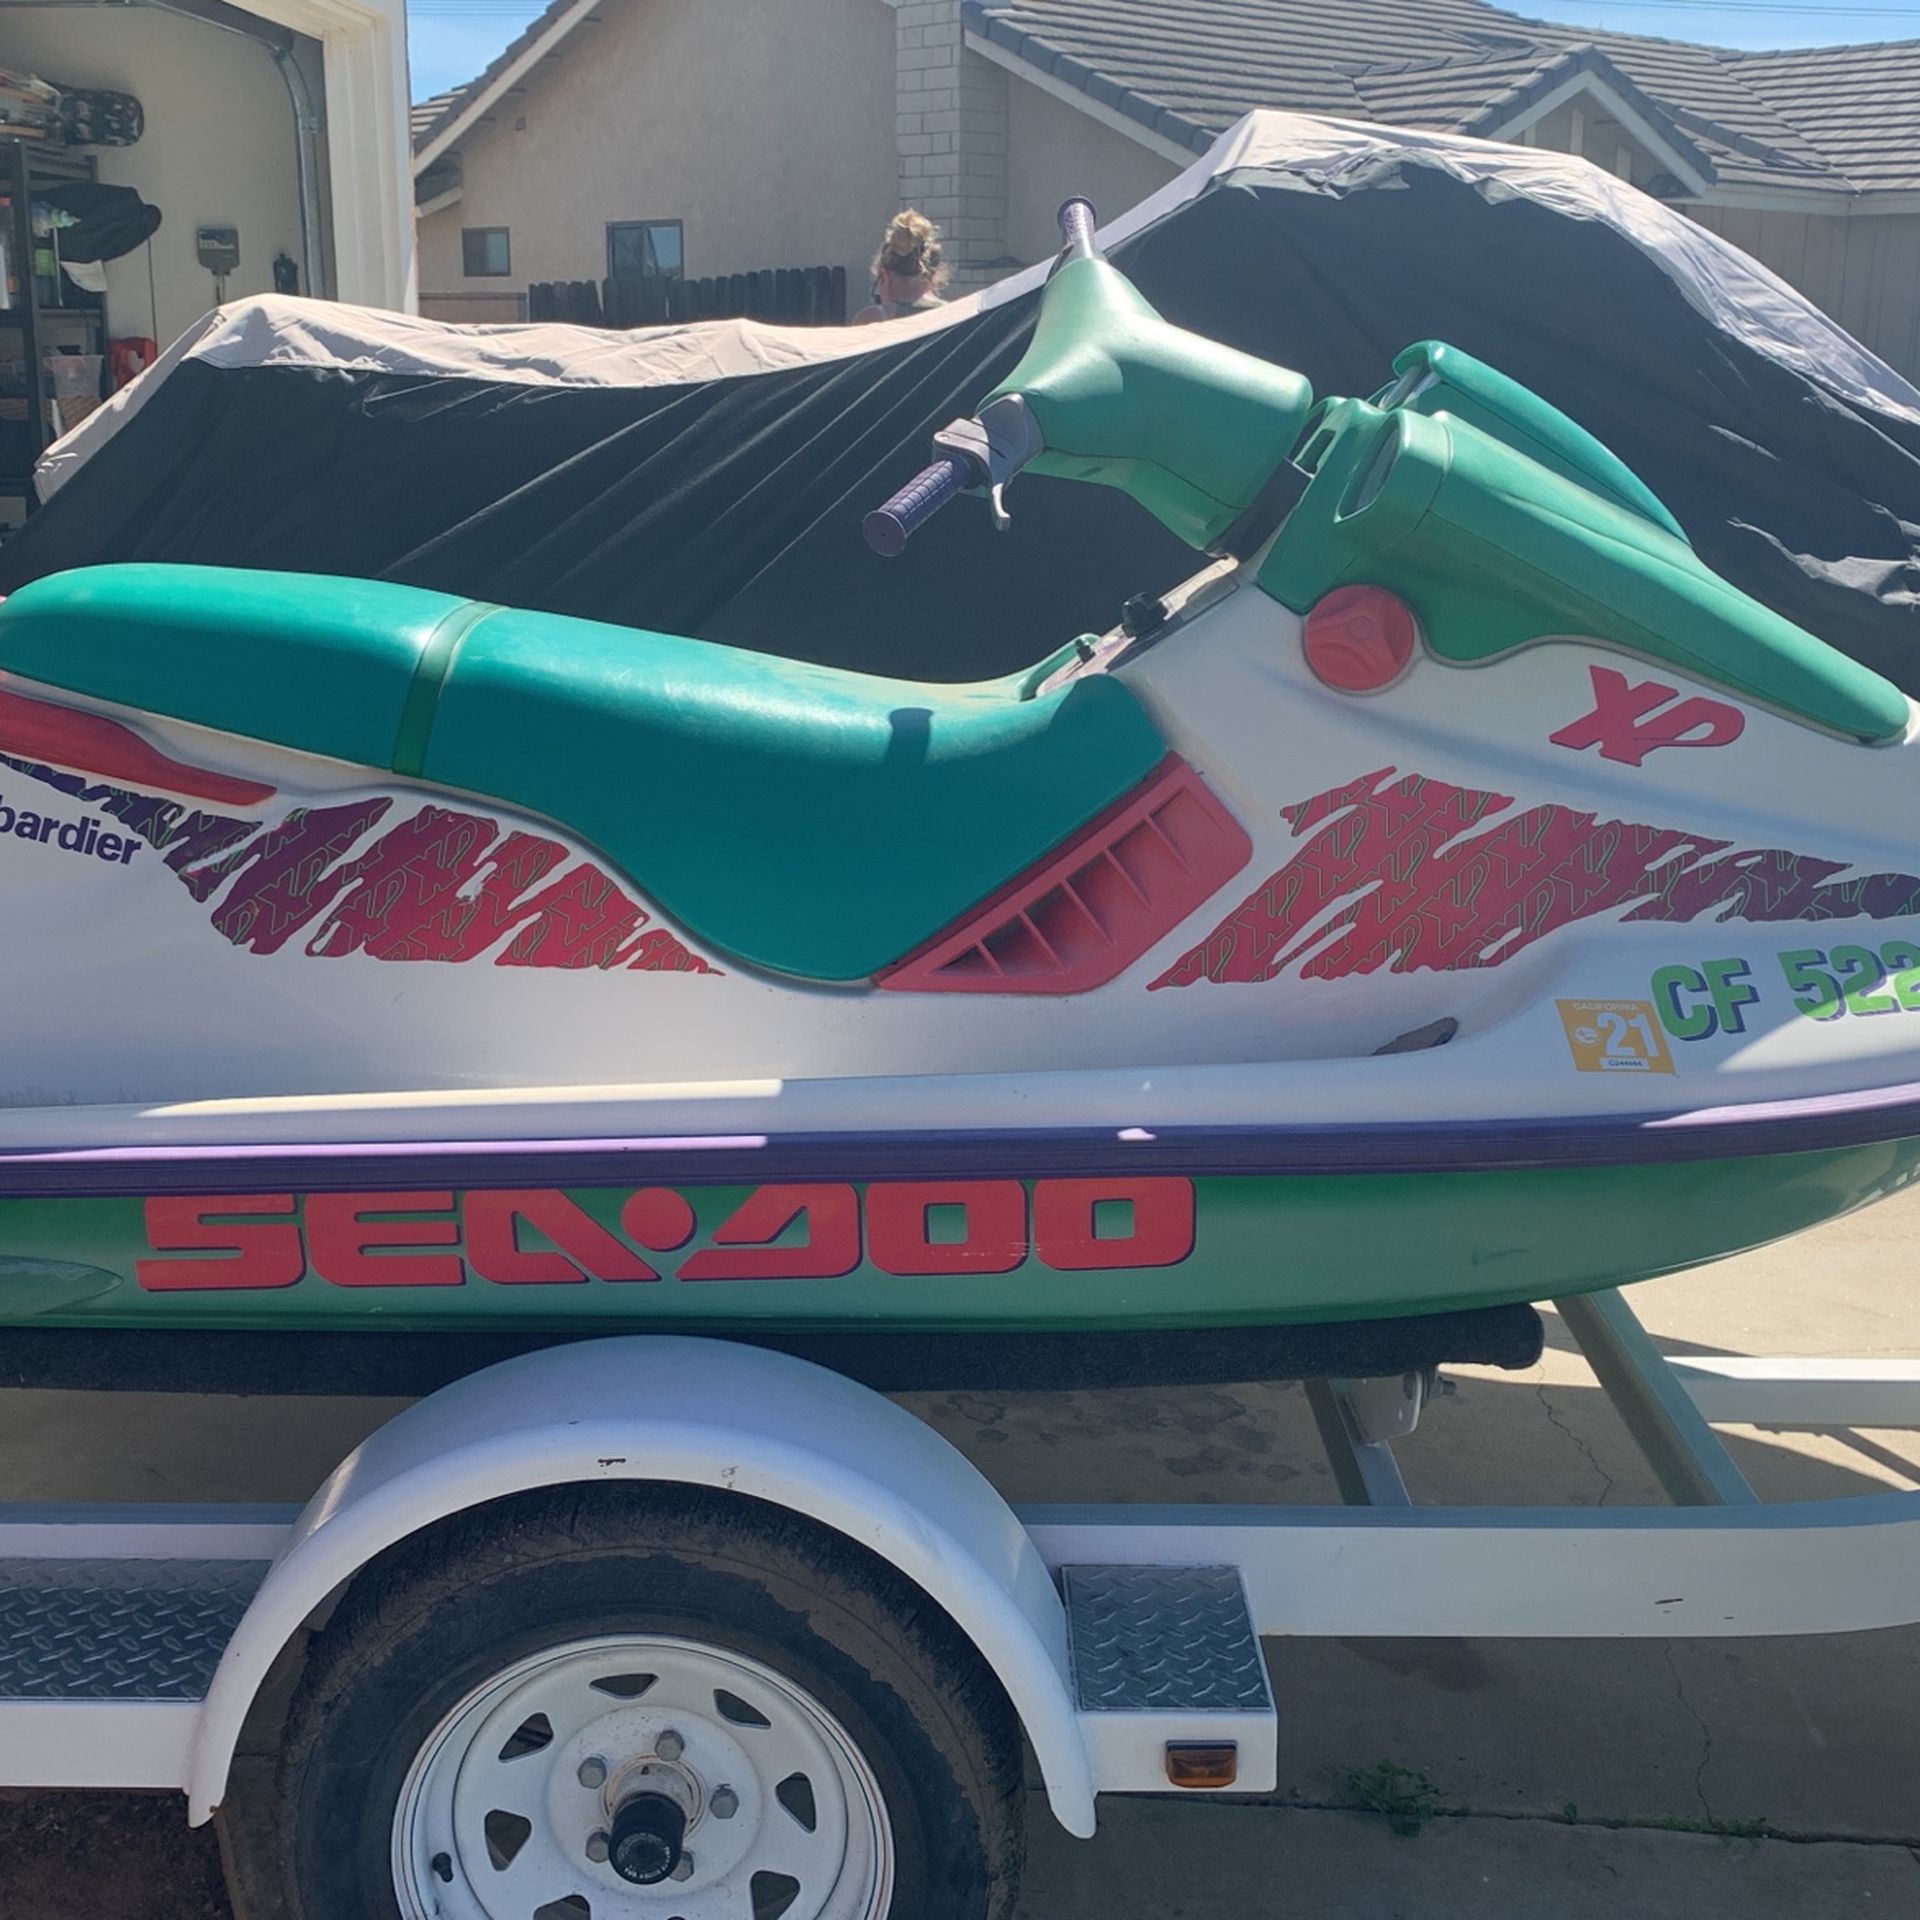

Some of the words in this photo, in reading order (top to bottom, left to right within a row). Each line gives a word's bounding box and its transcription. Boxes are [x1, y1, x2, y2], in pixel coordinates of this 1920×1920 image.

[1548, 664, 1746, 767] XP
[0, 795, 142, 865] bardier
[1596, 1011, 1660, 1058] 21
[1650, 957, 1760, 1041] CF
